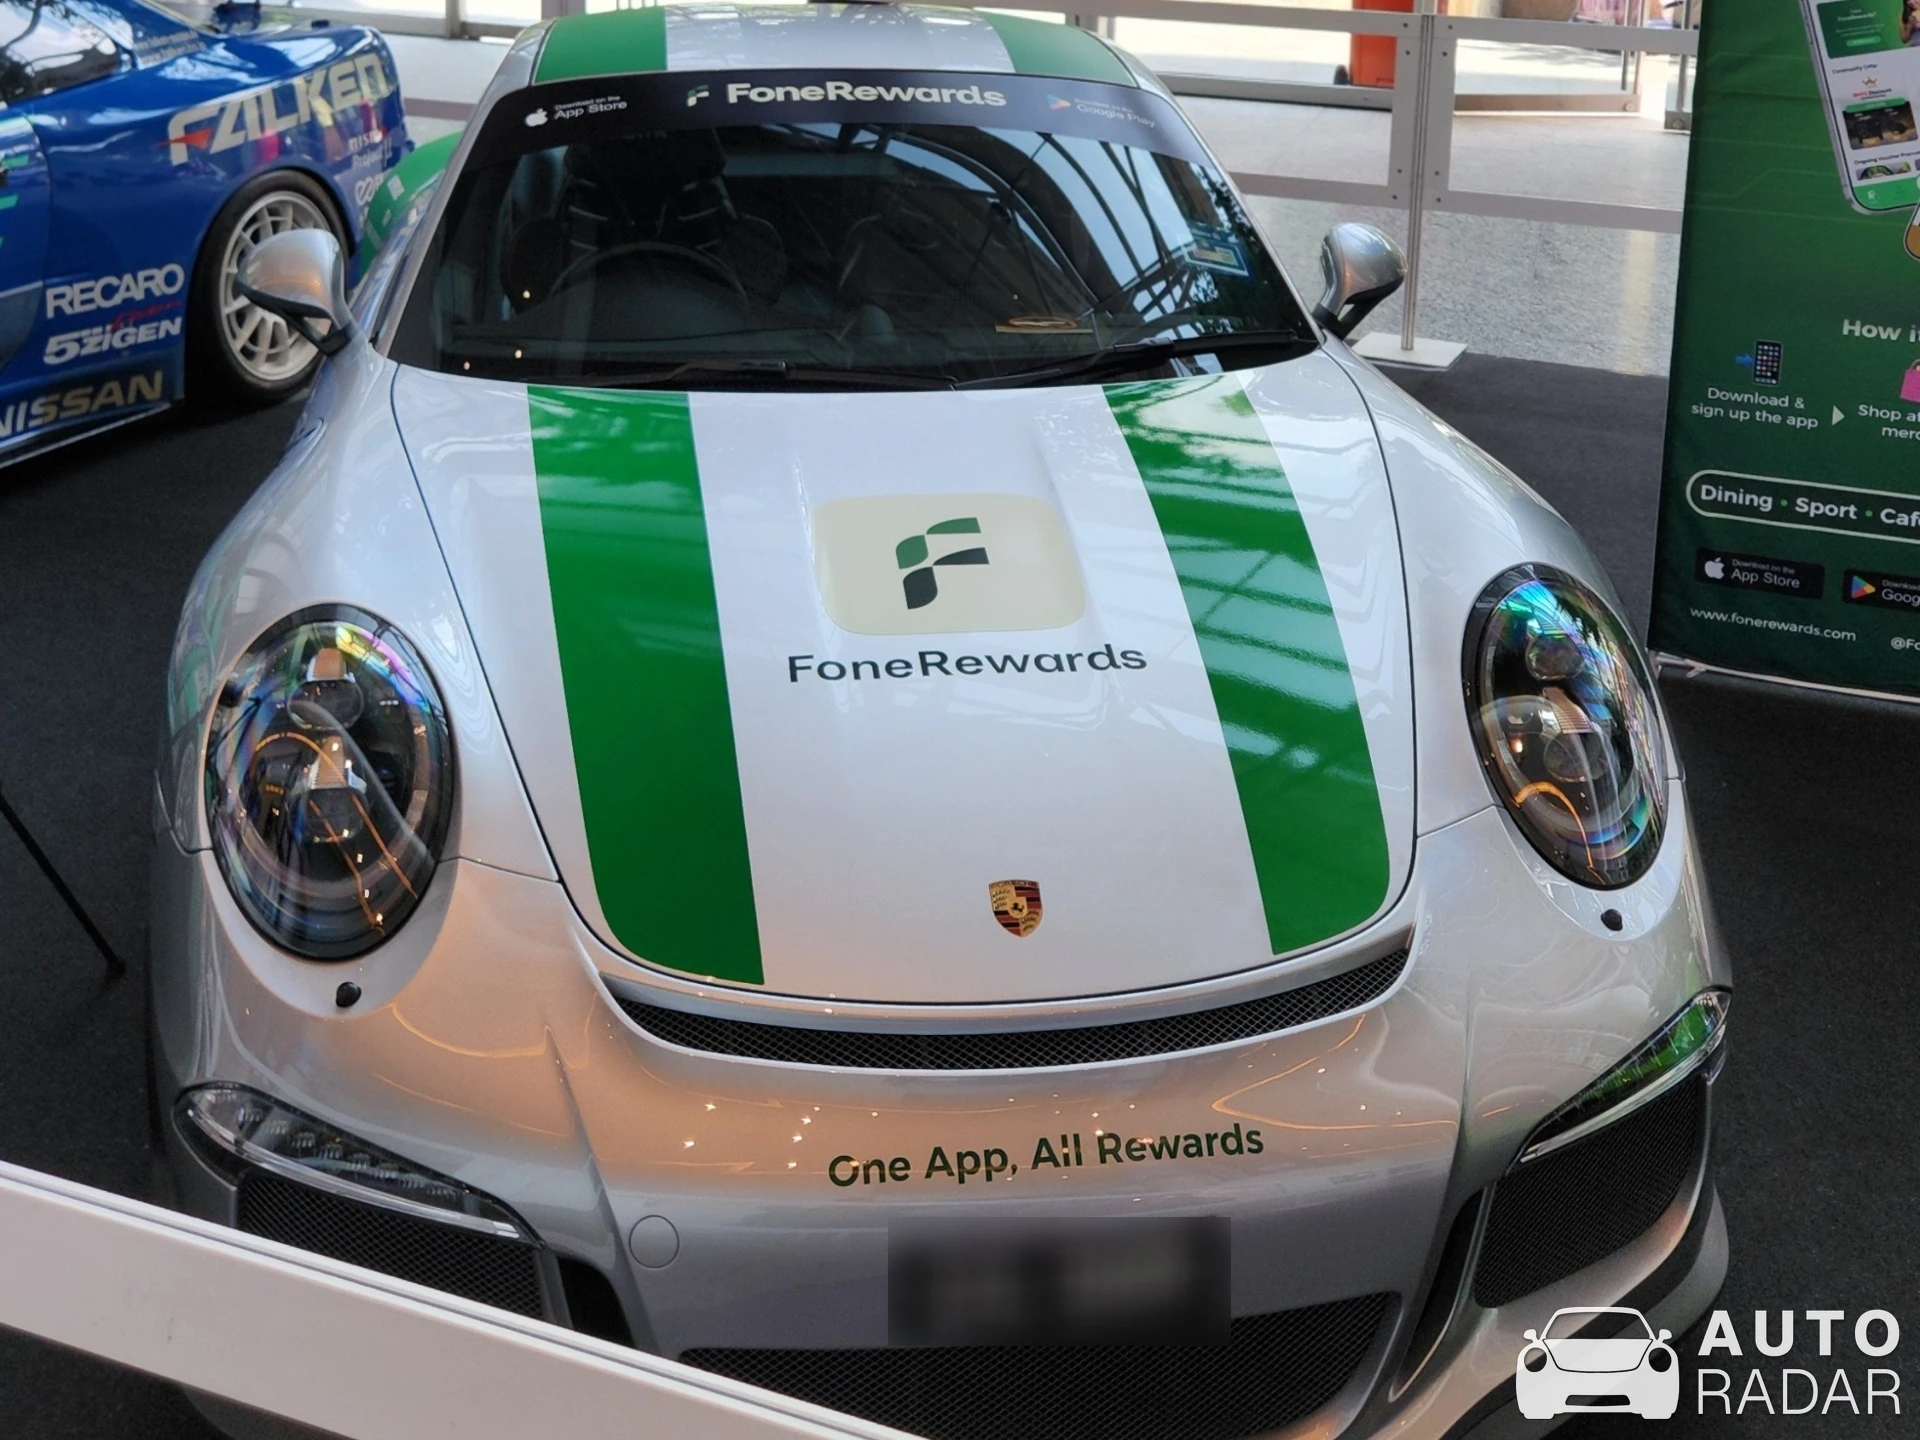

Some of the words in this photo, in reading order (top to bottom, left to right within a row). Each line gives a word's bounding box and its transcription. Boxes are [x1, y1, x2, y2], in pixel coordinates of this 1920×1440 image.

[726, 80, 1007, 107] FoneRewards
[158, 51, 390, 168] FALKEN
[554, 107, 584, 120] App
[588, 101, 628, 114] Store
[1076, 103, 1125, 119] Google
[1126, 113, 1156, 129] Play
[46, 263, 185, 319] RECARO
[43, 316, 183, 366] 5ZIGEN
[1842, 318, 1902, 341] How
[1707, 387, 1790, 408] Download
[1794, 396, 1805, 409] &
[1691, 403, 1724, 418] sign
[1728, 409, 1751, 422] up
[1755, 410, 1782, 424] the
[1786, 415, 1819, 430] app
[1858, 404, 1902, 422] Shop
[1700, 483, 1773, 513] Dining
[1795, 496, 1858, 521] Sport
[1880, 507, 1920, 528] Caf
[1731, 568, 1759, 584] App
[1763, 572, 1801, 589] Store
[1732, 558, 1770, 571] Download
[1783, 566, 1796, 575] the
[1689, 607, 1857, 642] www.fonerewards.com
[788, 644, 1147, 683] FoneRewards
[828, 1154, 912, 1187] One
[924, 1145, 1019, 1184] App,
[1031, 1133, 1083, 1170] All
[1099, 1122, 1265, 1164] Rewards
